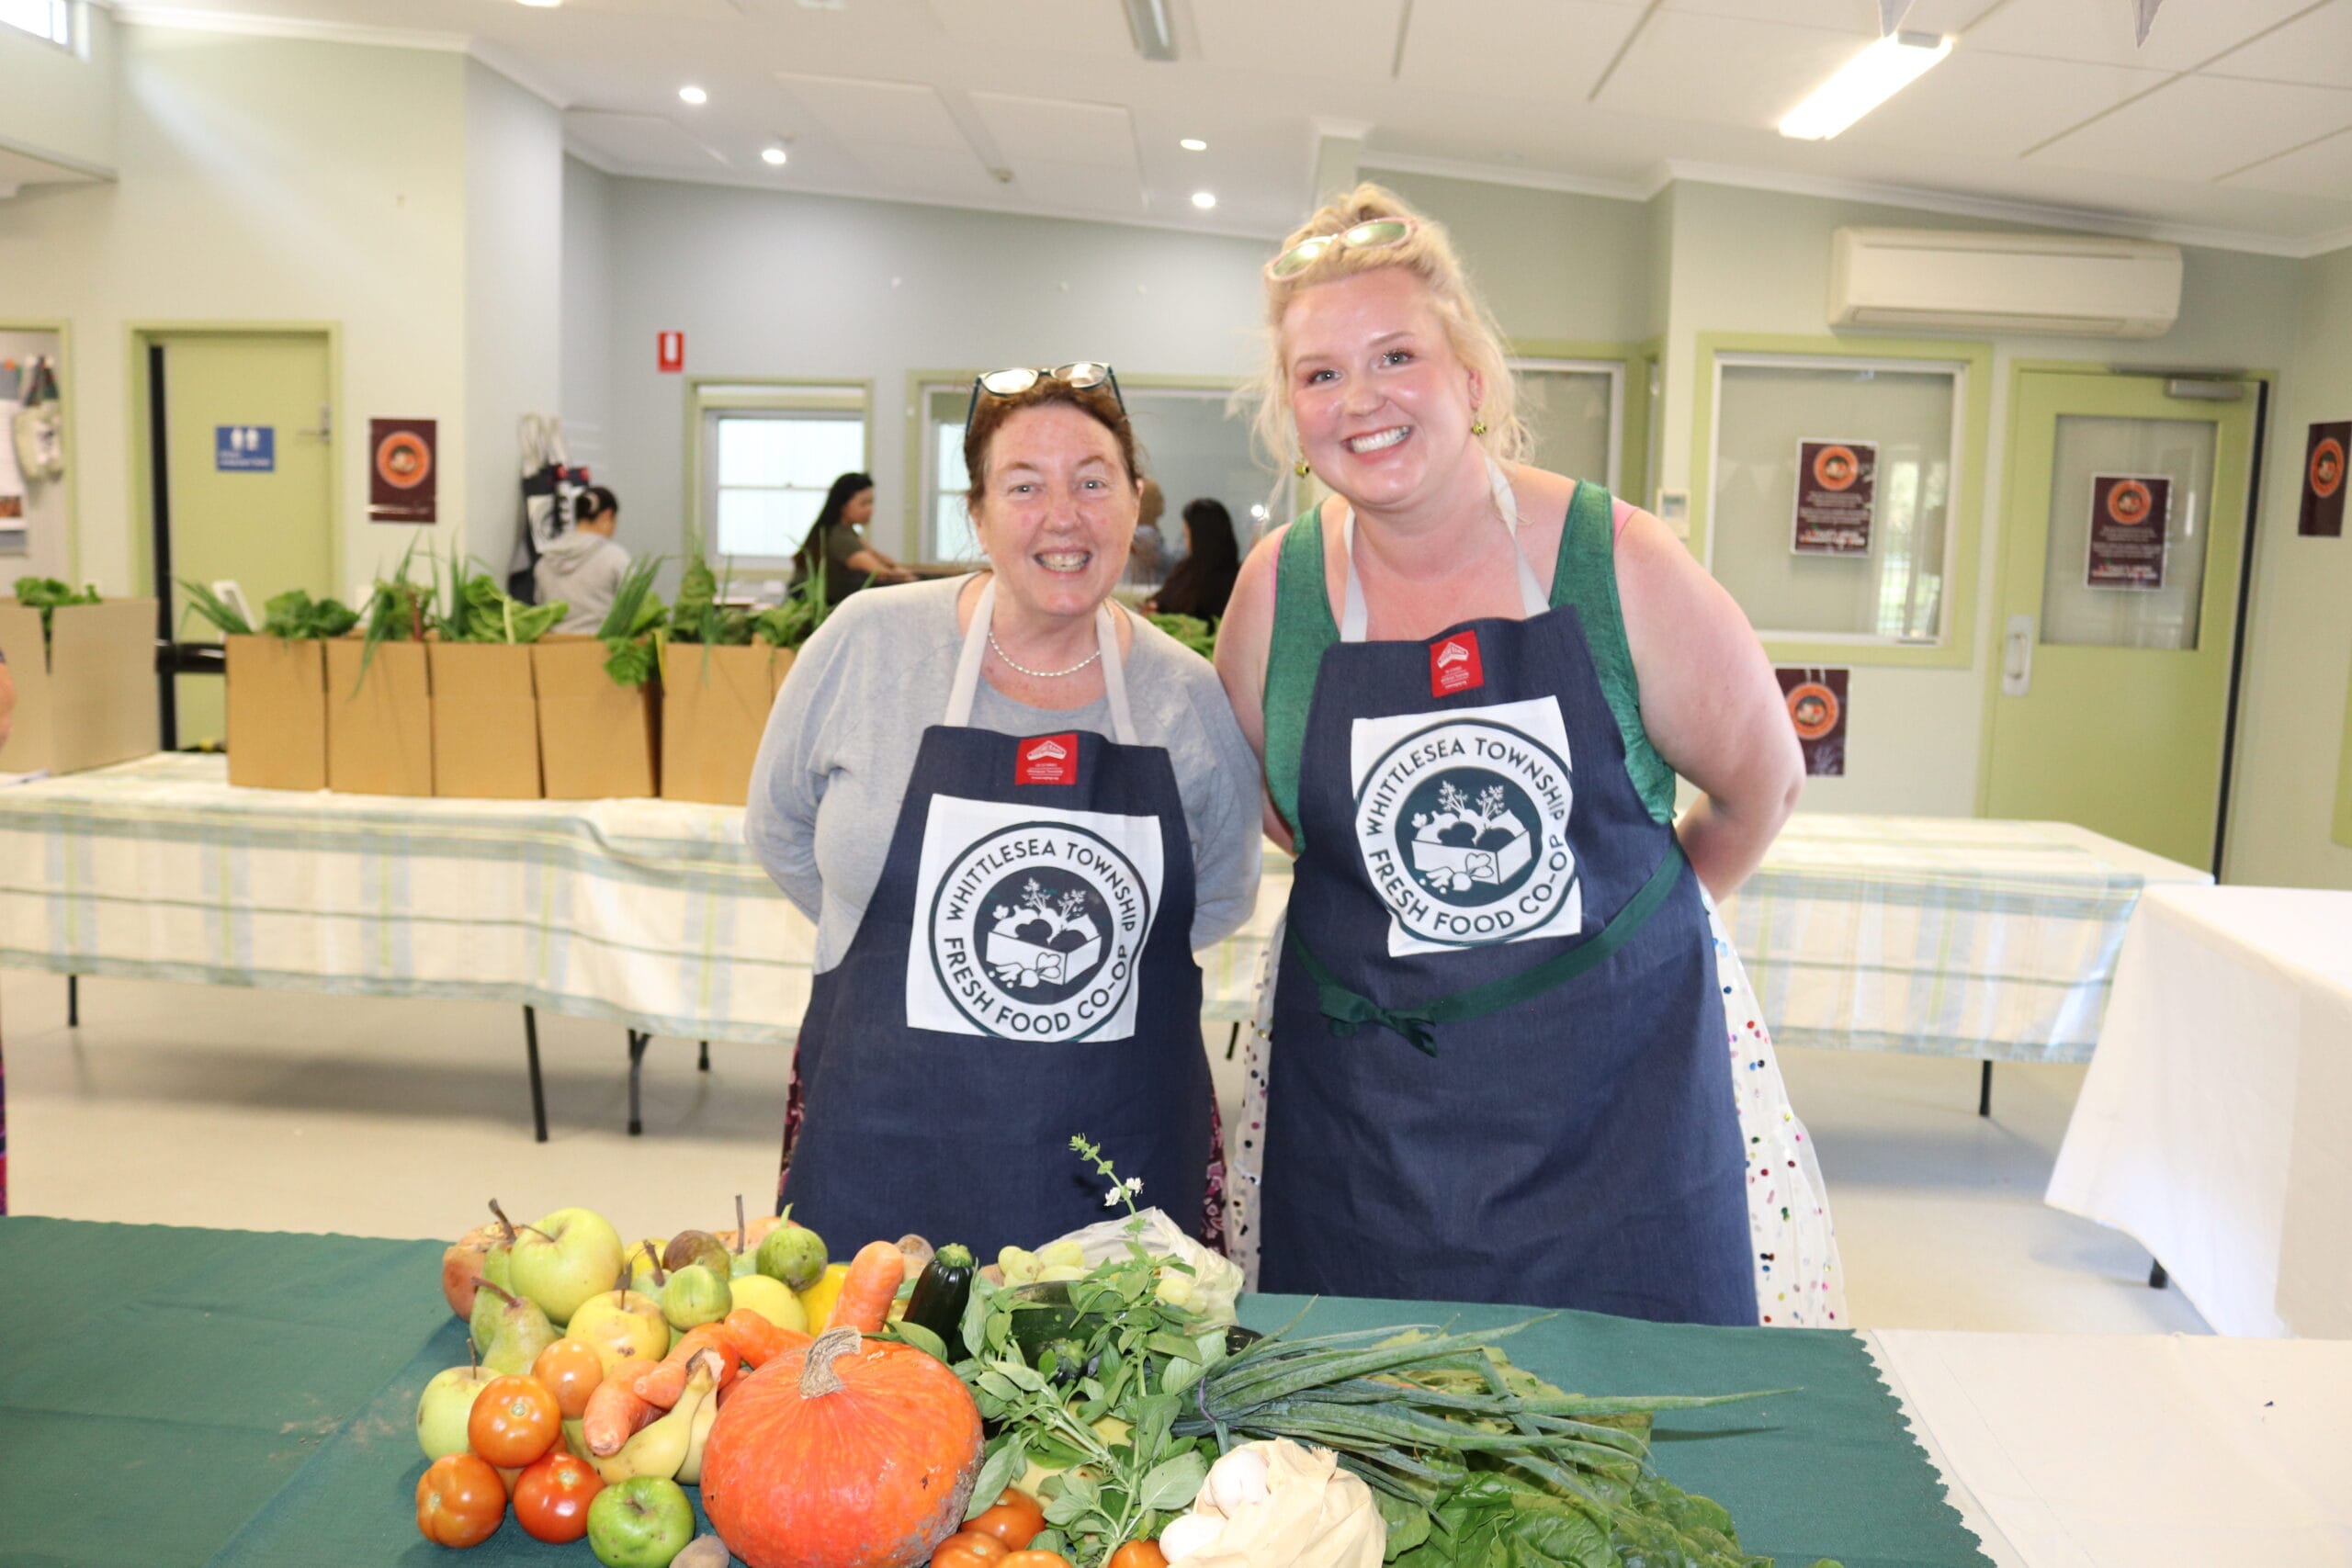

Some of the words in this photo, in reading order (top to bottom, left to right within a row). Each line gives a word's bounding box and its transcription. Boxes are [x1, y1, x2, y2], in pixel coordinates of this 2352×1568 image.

[1366, 739, 1465, 836] WHITTLESEA
[1475, 738, 1564, 820] TOWNSHIP
[947, 839, 1057, 920] WHITTLESEA
[1067, 842, 1136, 931] TOWNSHIP
[1369, 849, 1429, 922] FRESH
[1434, 910, 1514, 934] FOOD
[1519, 834, 1567, 914] CO-OP
[944, 937, 994, 1013] FRESH
[996, 1006, 1070, 1034] FOOD
[1078, 945, 1127, 1020] CO-OP
